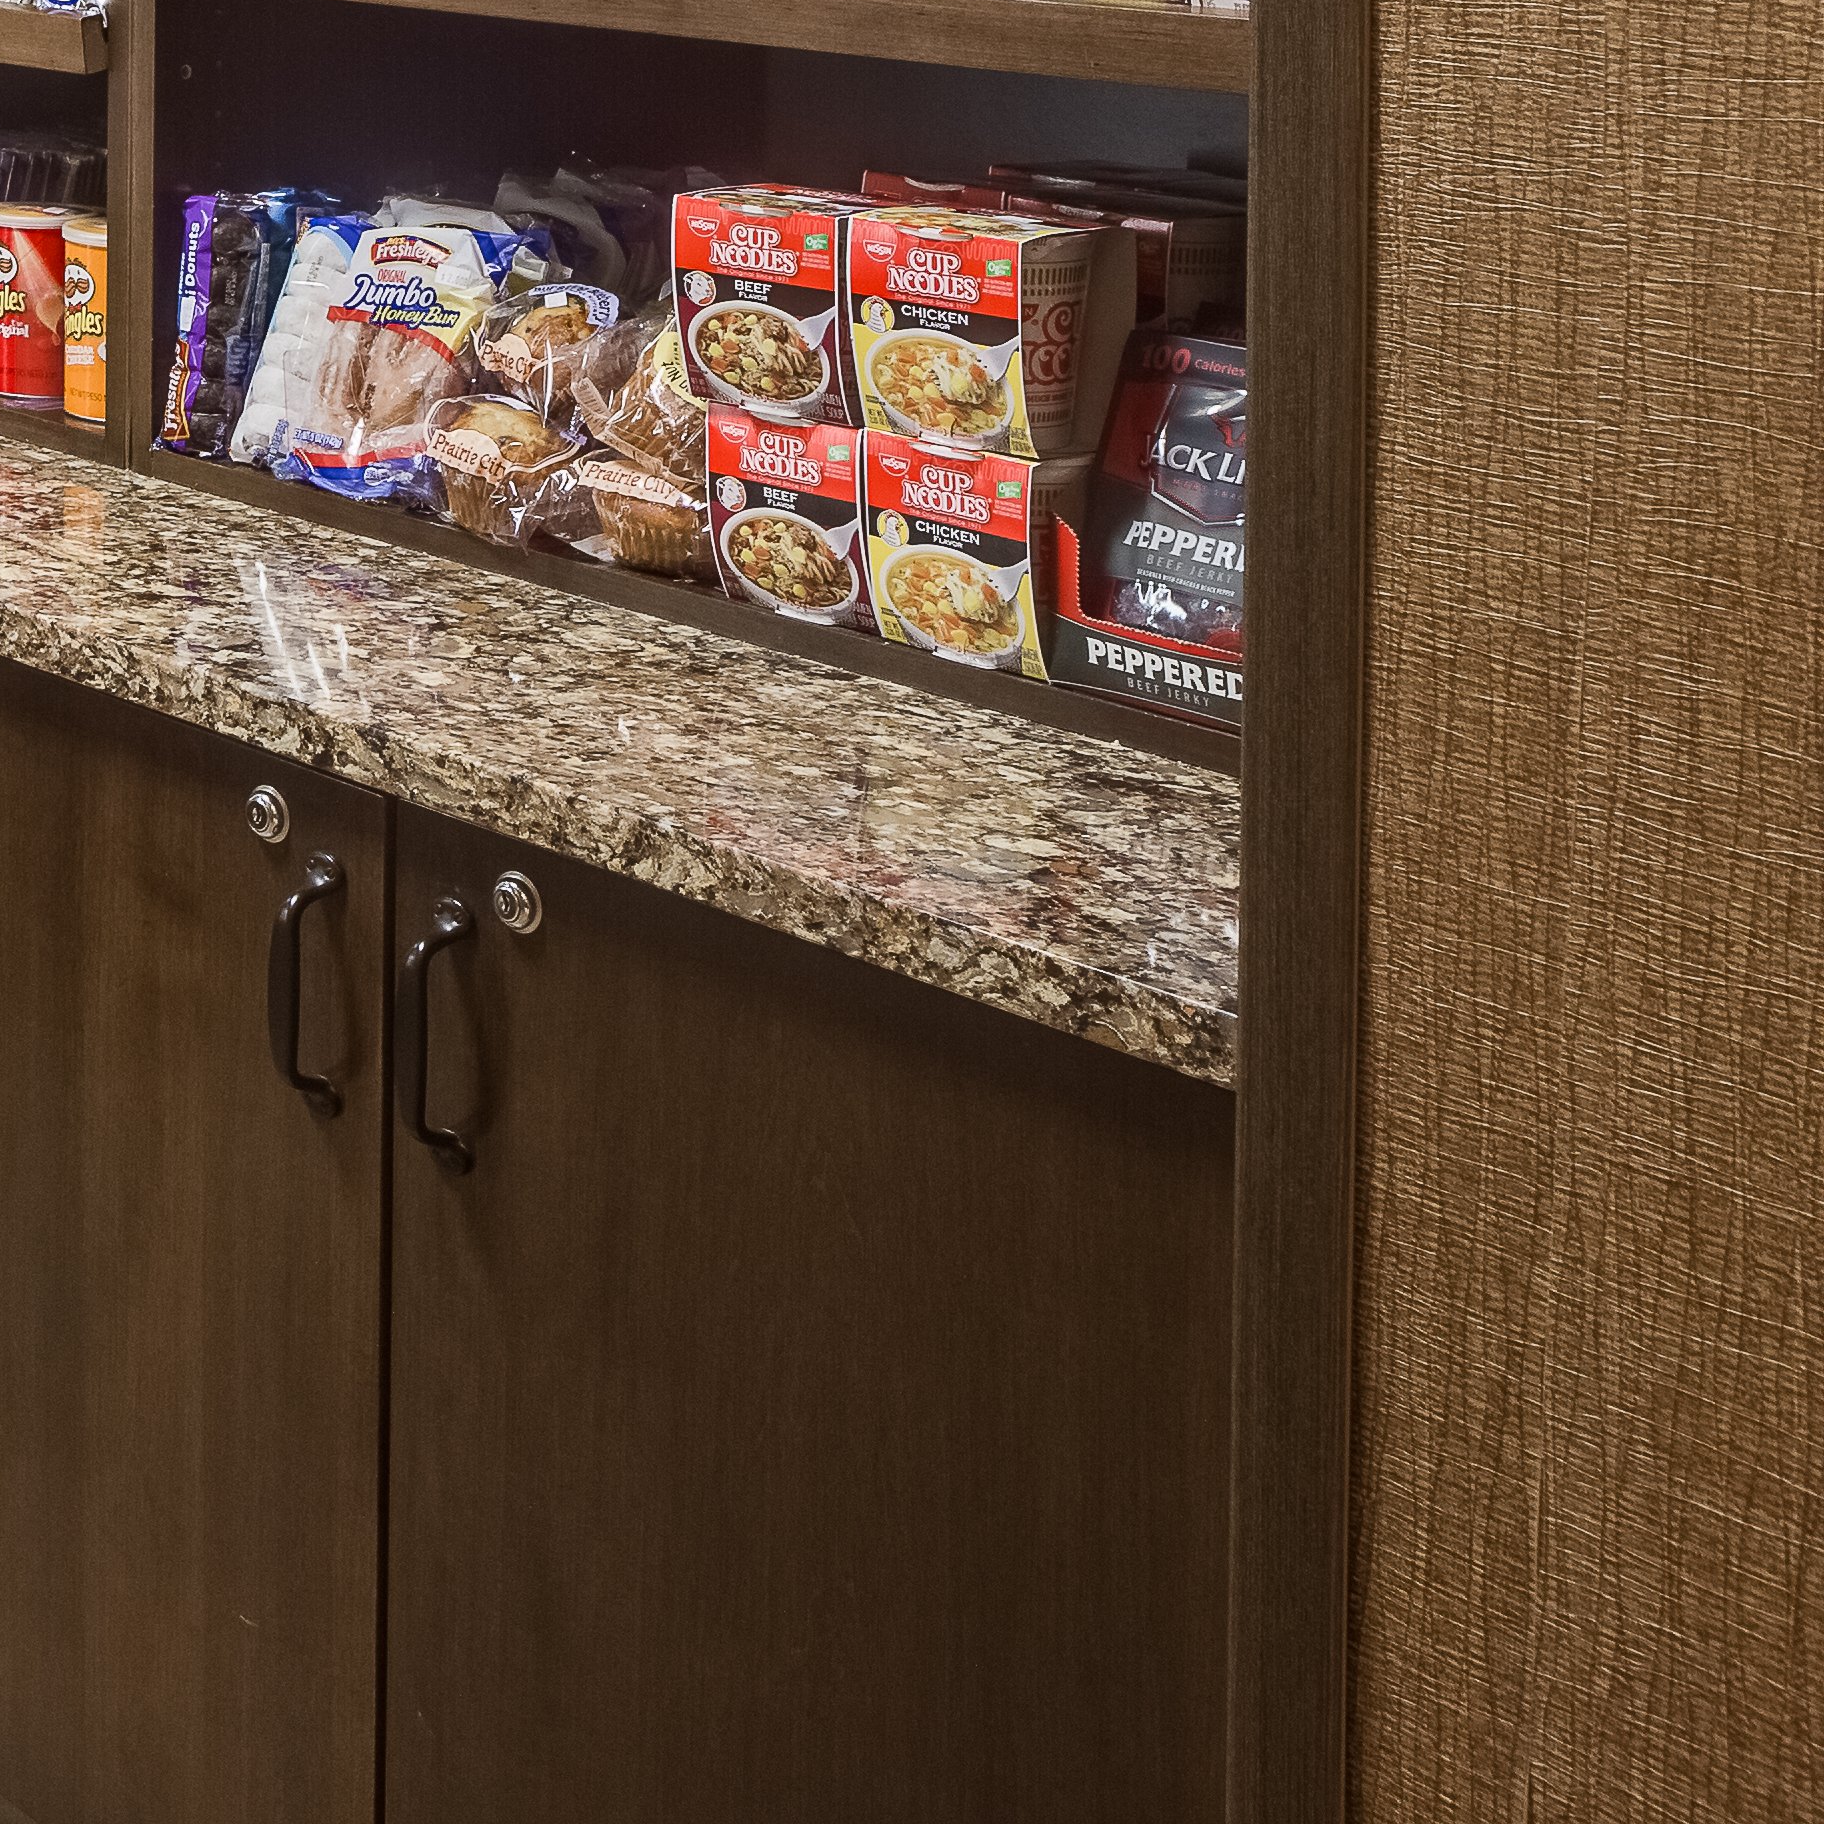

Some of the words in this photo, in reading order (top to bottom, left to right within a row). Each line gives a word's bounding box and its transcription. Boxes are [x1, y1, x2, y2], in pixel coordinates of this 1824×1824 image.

[729, 224, 780, 248] CUP
[186, 222, 199, 286] Donuts
[711, 244, 797, 275] NOODLES
[908, 248, 961, 274] CUP
[378, 269, 406, 283] ORIGINAL
[734, 280, 772, 296] BEEF
[887, 266, 979, 303] NOODLES
[344, 277, 437, 308] Jumbo
[372, 305, 424, 325] Honey
[426, 308, 460, 327] Bun
[901, 304, 969, 327] CHICKEN
[920, 319, 951, 330] FLAVOR
[1195, 359, 1246, 377] calories
[434, 434, 478, 468] Prairie
[478, 452, 506, 477] City
[758, 431, 806, 454] CUP
[740, 447, 821, 485] NOODLES
[1141, 434, 1220, 482] JACK
[586, 463, 641, 488] Prairie
[642, 471, 676, 499] City
[922, 465, 973, 489] CUP
[763, 487, 798, 504] BEEF
[901, 484, 990, 522] NOODLES
[915, 521, 980, 546] CHICKEN
[1146, 554, 1184, 569] BEEF
[1188, 565, 1234, 583] JERKY
[1086, 636, 1242, 701] PEPPERED
[1127, 677, 1161, 696] BEEF
[1167, 685, 1210, 708] JERKY
